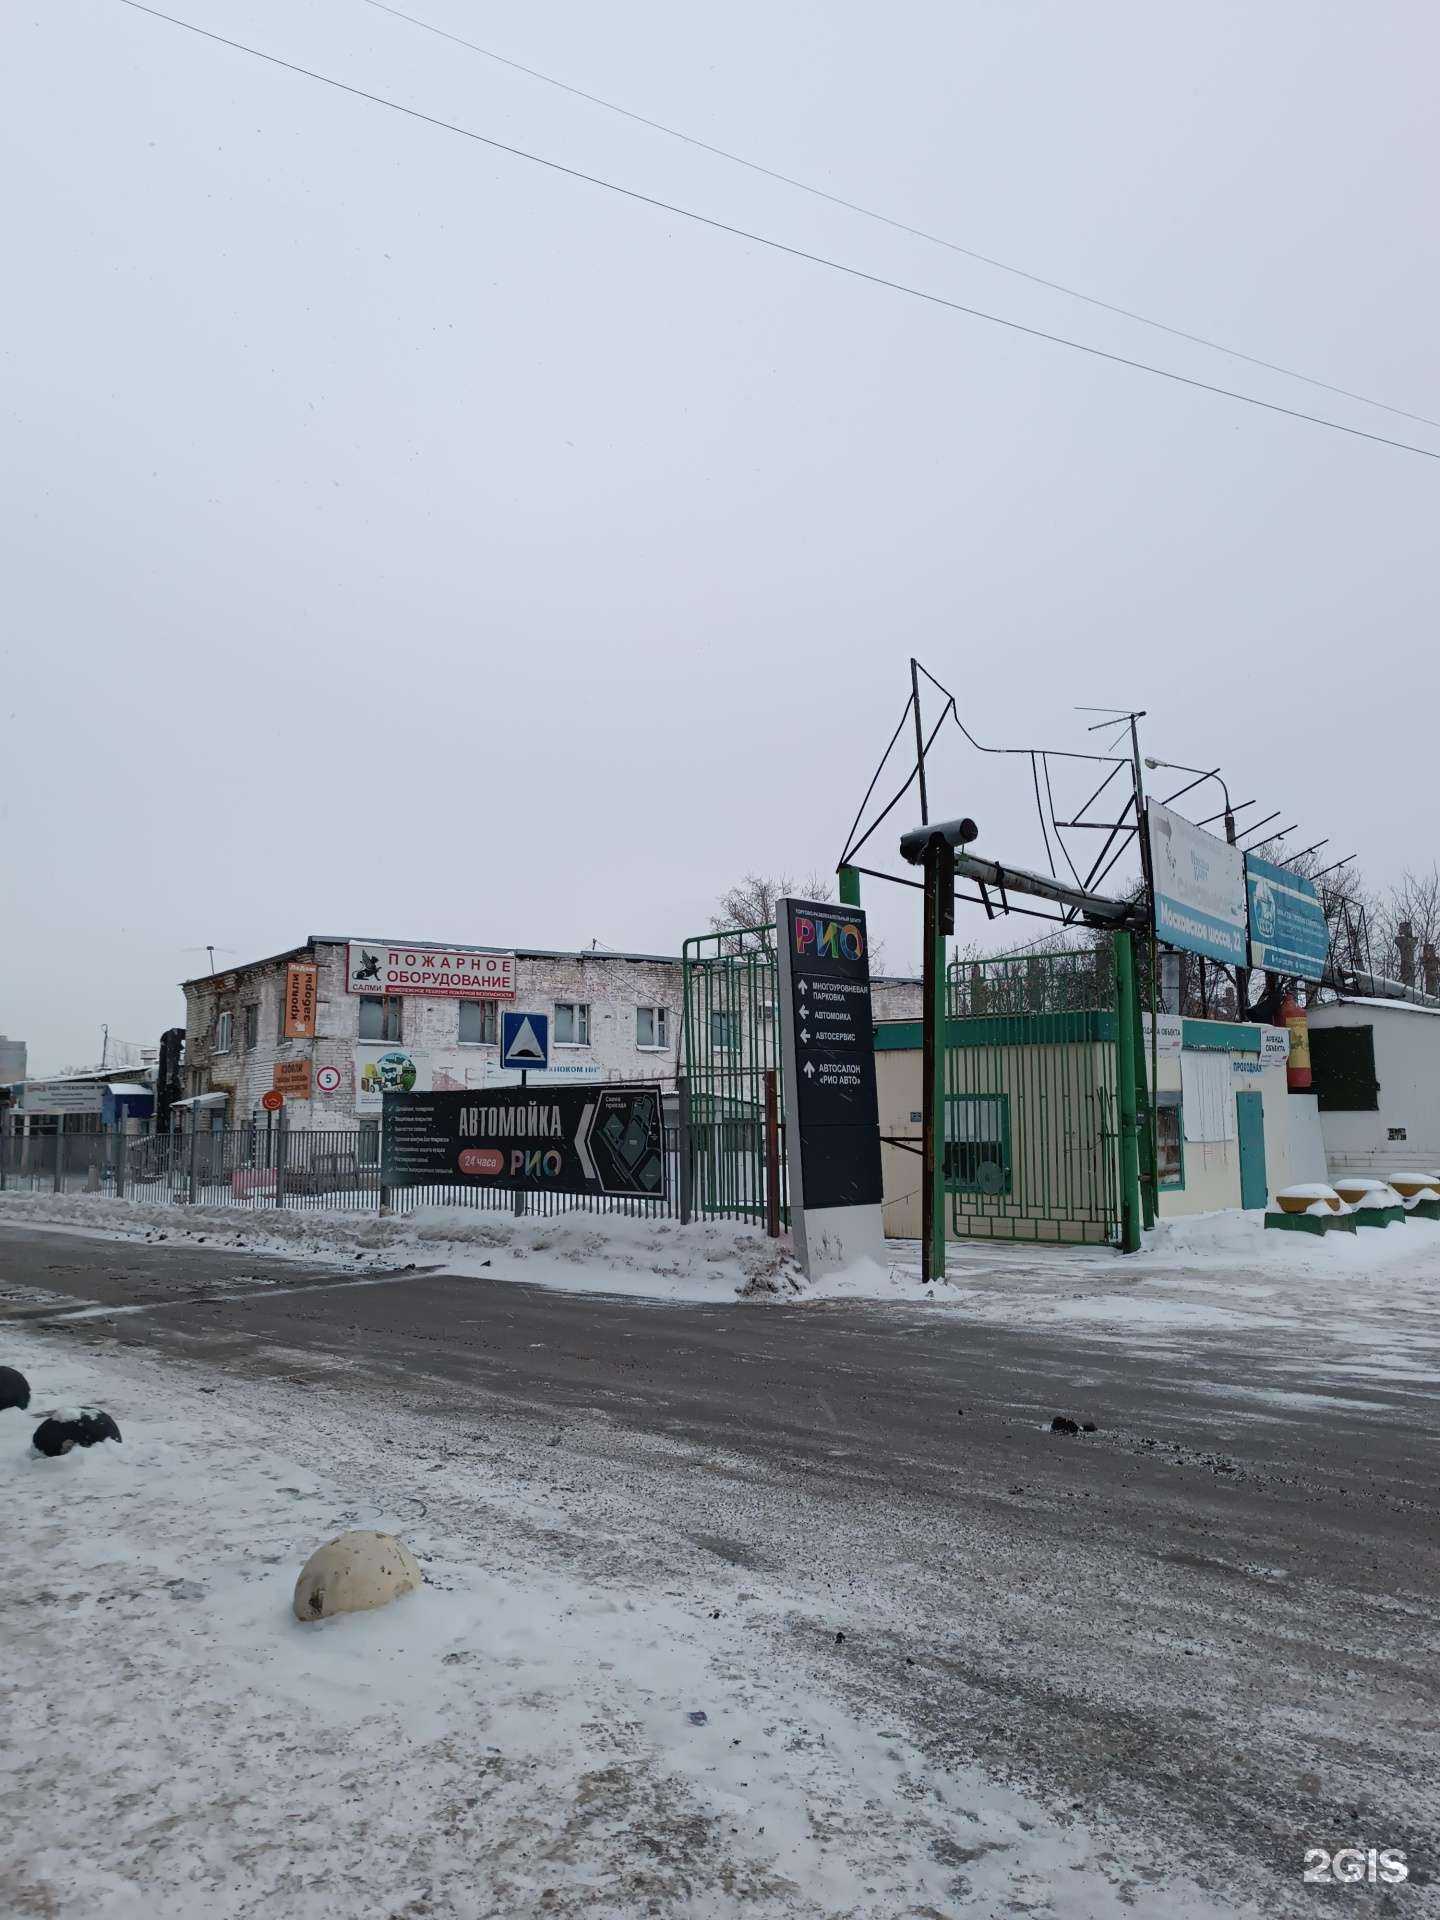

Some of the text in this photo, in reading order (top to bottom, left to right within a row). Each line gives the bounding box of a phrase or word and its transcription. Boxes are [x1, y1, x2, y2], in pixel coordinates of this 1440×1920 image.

[1160, 900, 1207, 940] Московское
[795, 917, 864, 960] РИО
[388, 953, 511, 972] ПОЖАРНОЕ
[387, 970, 511, 988] ОБОРУДОВАНИЕ
[352, 983, 383, 992] САЛМИ
[812, 982, 868, 994] МНОГОУРОВНЕВАЯ
[290, 973, 300, 1020] кровли
[302, 973, 314, 1022] заборы
[813, 992, 846, 1002] ПАРКОВКА
[815, 1032, 856, 1041] АВТОСЕРВИС
[1266, 1035, 1284, 1043] АРЕНДА
[1265, 1044, 1286, 1052] ОБЪЕКТА
[819, 1064, 861, 1074] АВТОСАЛОН
[1233, 1062, 1263, 1074] ПРОХОДНАЯ
[325, 1074, 332, 1084] 5
[839, 1076, 861, 1085] АВТО»
[459, 1100, 562, 1137] АВТОМОЙКА
[464, 1155, 497, 1168] 24 часа
[510, 1150, 562, 1177] РИО
